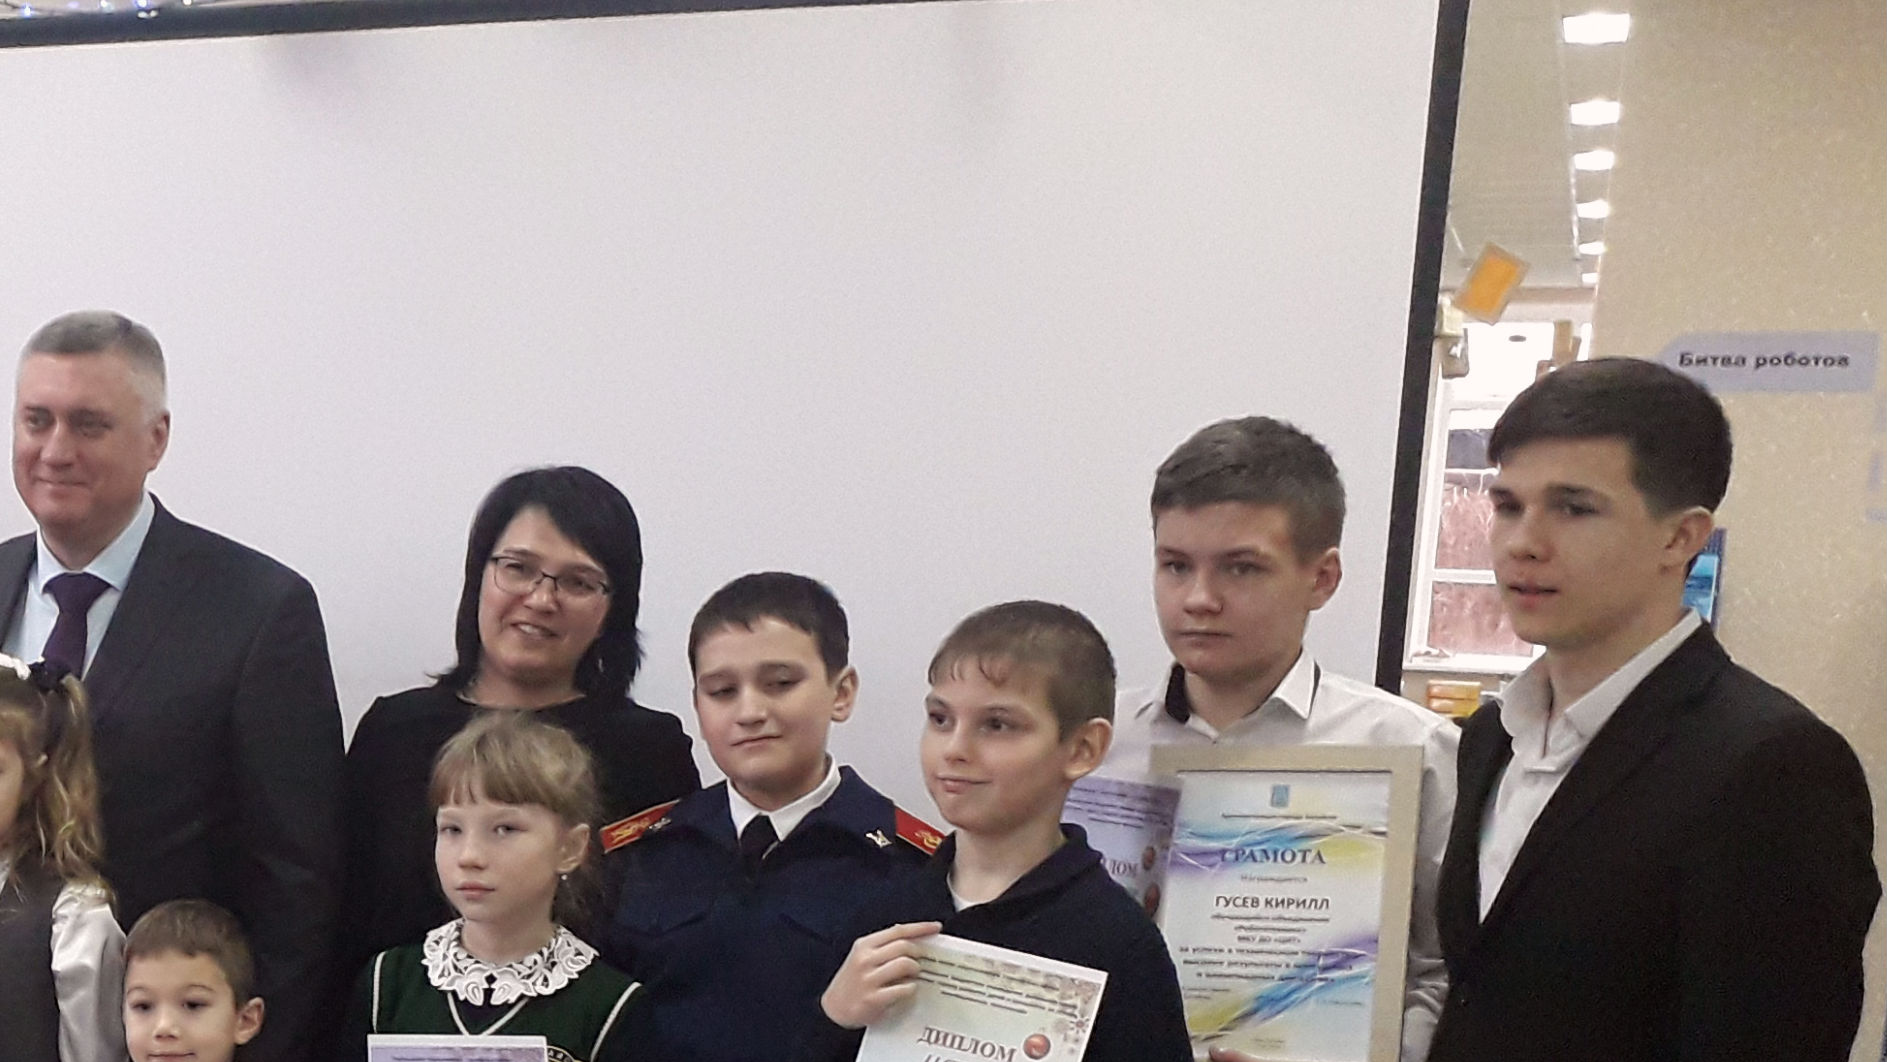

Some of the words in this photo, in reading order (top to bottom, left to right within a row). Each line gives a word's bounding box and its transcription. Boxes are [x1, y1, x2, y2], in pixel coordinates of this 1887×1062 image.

[1678, 352, 1747, 367] Битва
[1754, 351, 1850, 369] роботов
[1220, 848, 1326, 865] ГРАМОТА
[1215, 895, 1260, 909] ГУСЕВ
[1264, 897, 1330, 910] КИРИЛЛ
